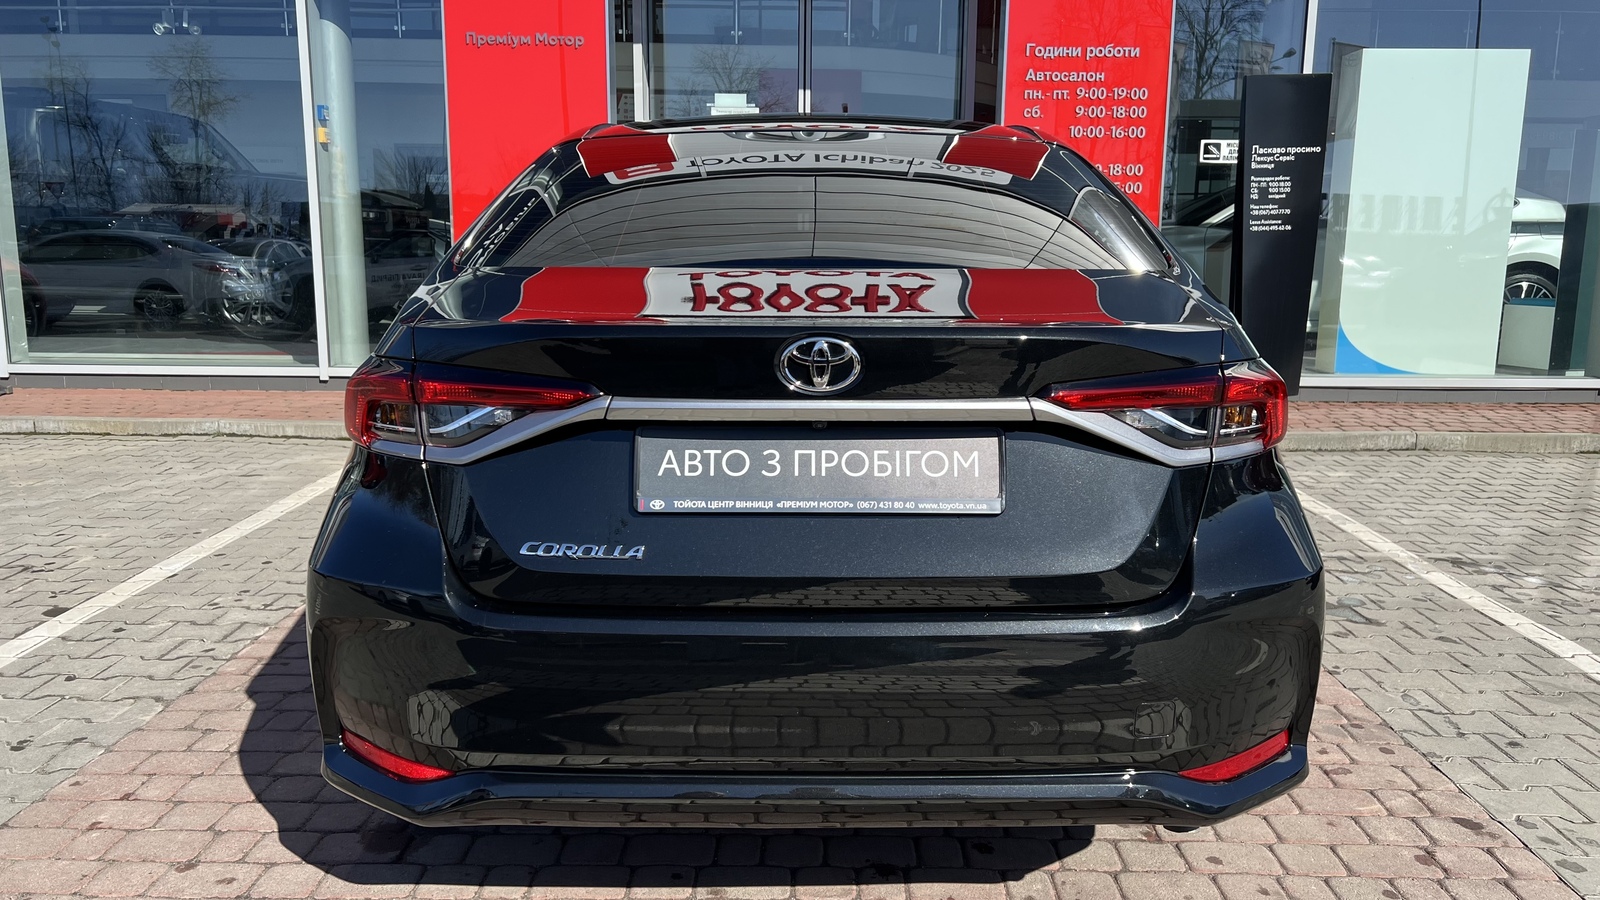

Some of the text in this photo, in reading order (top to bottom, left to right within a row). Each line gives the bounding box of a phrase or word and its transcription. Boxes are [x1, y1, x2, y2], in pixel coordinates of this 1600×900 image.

[465, 31, 585, 49] Преміум Мотор
[1025, 43, 1140, 60] Години роботи
[1025, 69, 1105, 82] Автосалон
[1076, 87, 1149, 101] 9:00-19:00
[1024, 105, 1148, 119] сб. 9:00-18:00
[1069, 125, 1146, 139] 10:00-16:00
[1252, 145, 1321, 154] Ласкаво просимо
[657, 449, 750, 477] АВТО
[793, 449, 981, 478] ПРОБІГОМ
[673, 499, 988, 510] ТОЙОТА ЦЕНТР ВІННИЦЯ «ПРЕМІУМ МОТОР» (067) 431 80 40 www.toyota.vn.ua
[519, 541, 646, 560] COROLLA
